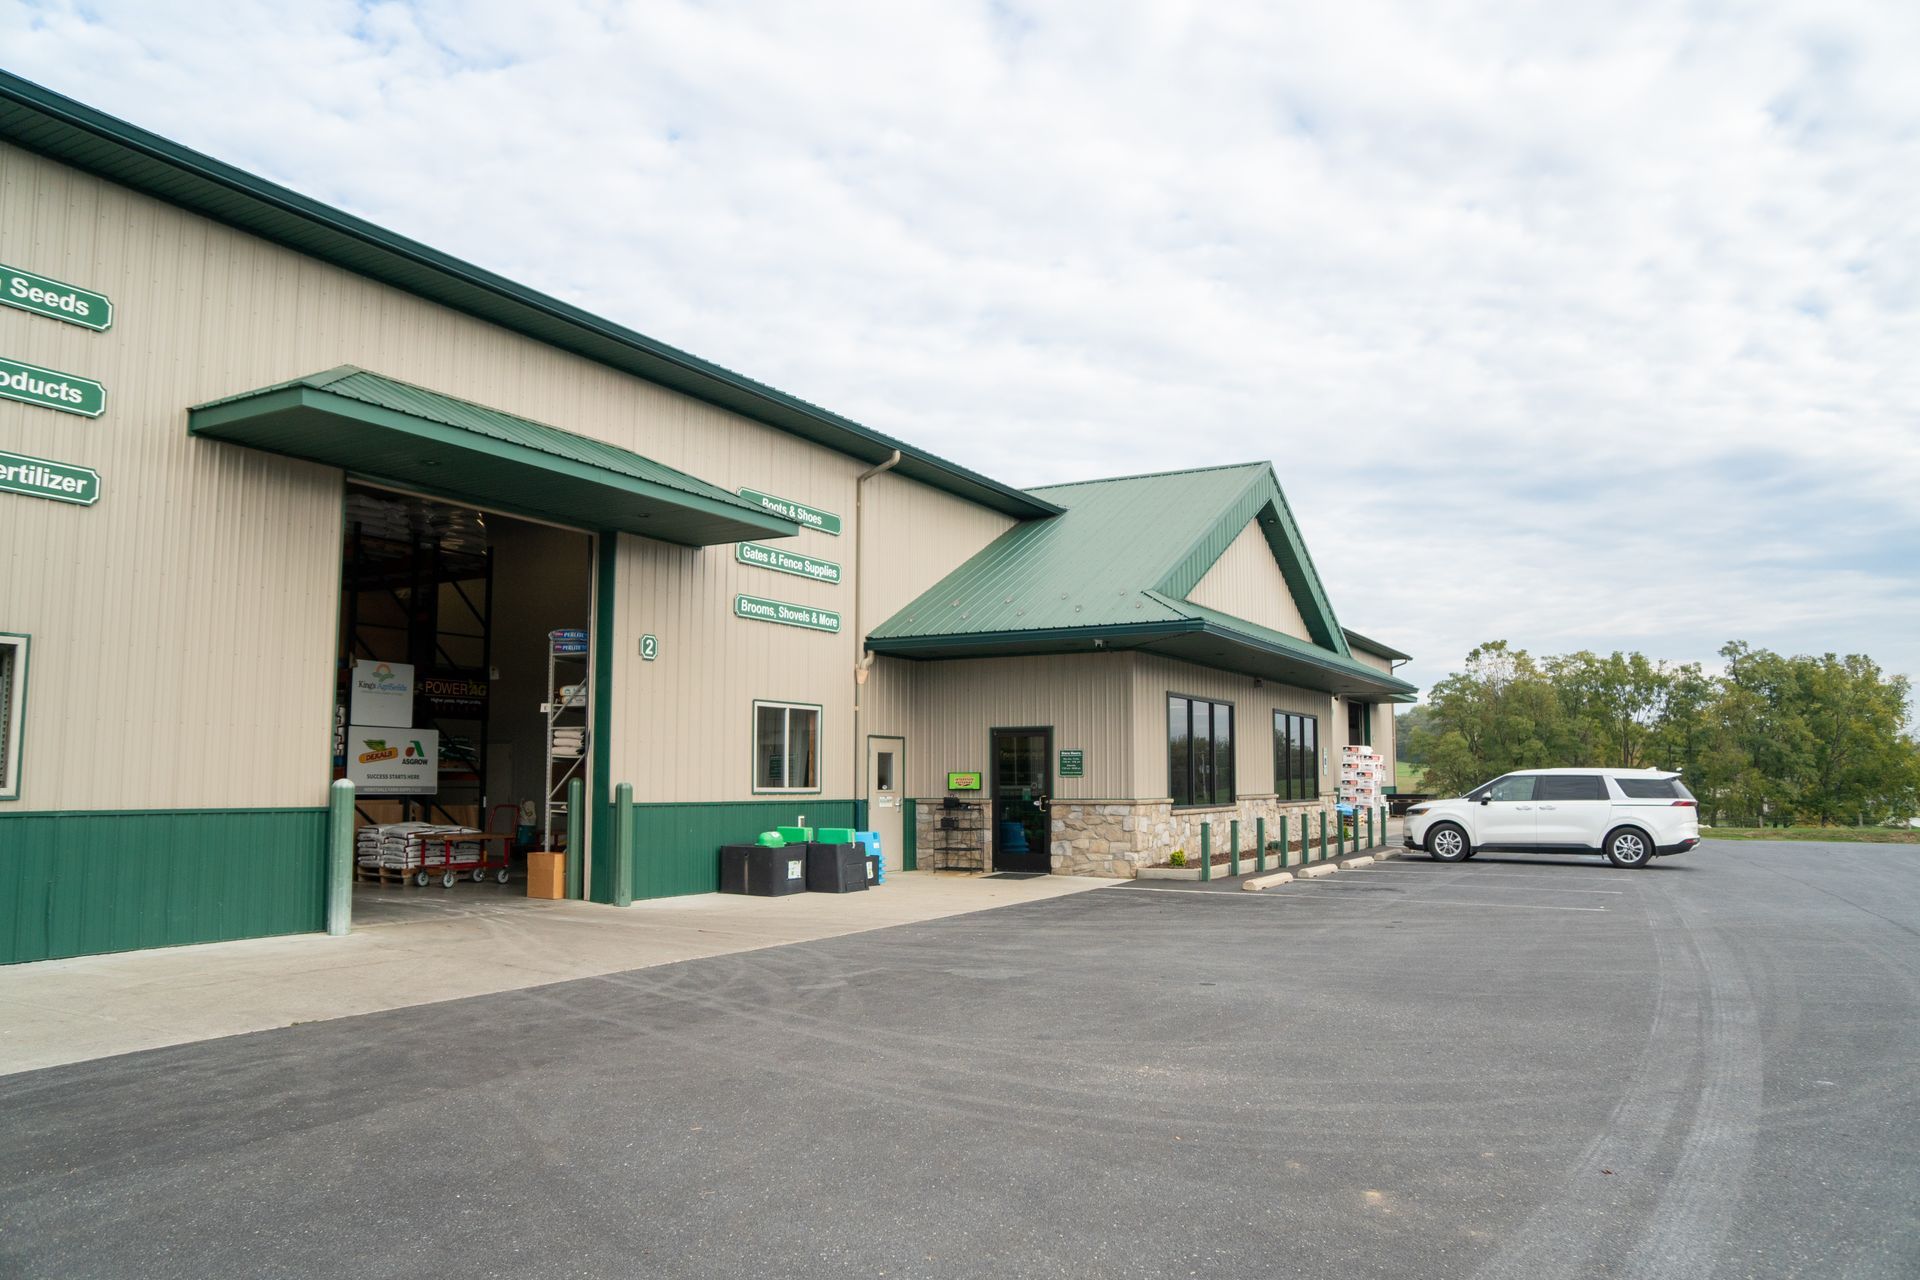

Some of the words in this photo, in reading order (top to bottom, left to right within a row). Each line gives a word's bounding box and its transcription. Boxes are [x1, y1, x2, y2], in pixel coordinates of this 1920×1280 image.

[10, 277, 90, 317] Seeds
[789, 505, 796, 517] &
[797, 508, 822, 525] Shoes
[743, 546, 768, 563] Gates
[770, 553, 777, 564] &
[778, 554, 803, 570] Fence
[804, 561, 837, 578] Supplies
[741, 600, 776, 619] Brooms,
[778, 607, 810, 623] Shovels
[812, 612, 818, 624] &
[819, 614, 838, 628] More
[645, 639, 653, 655] 2
